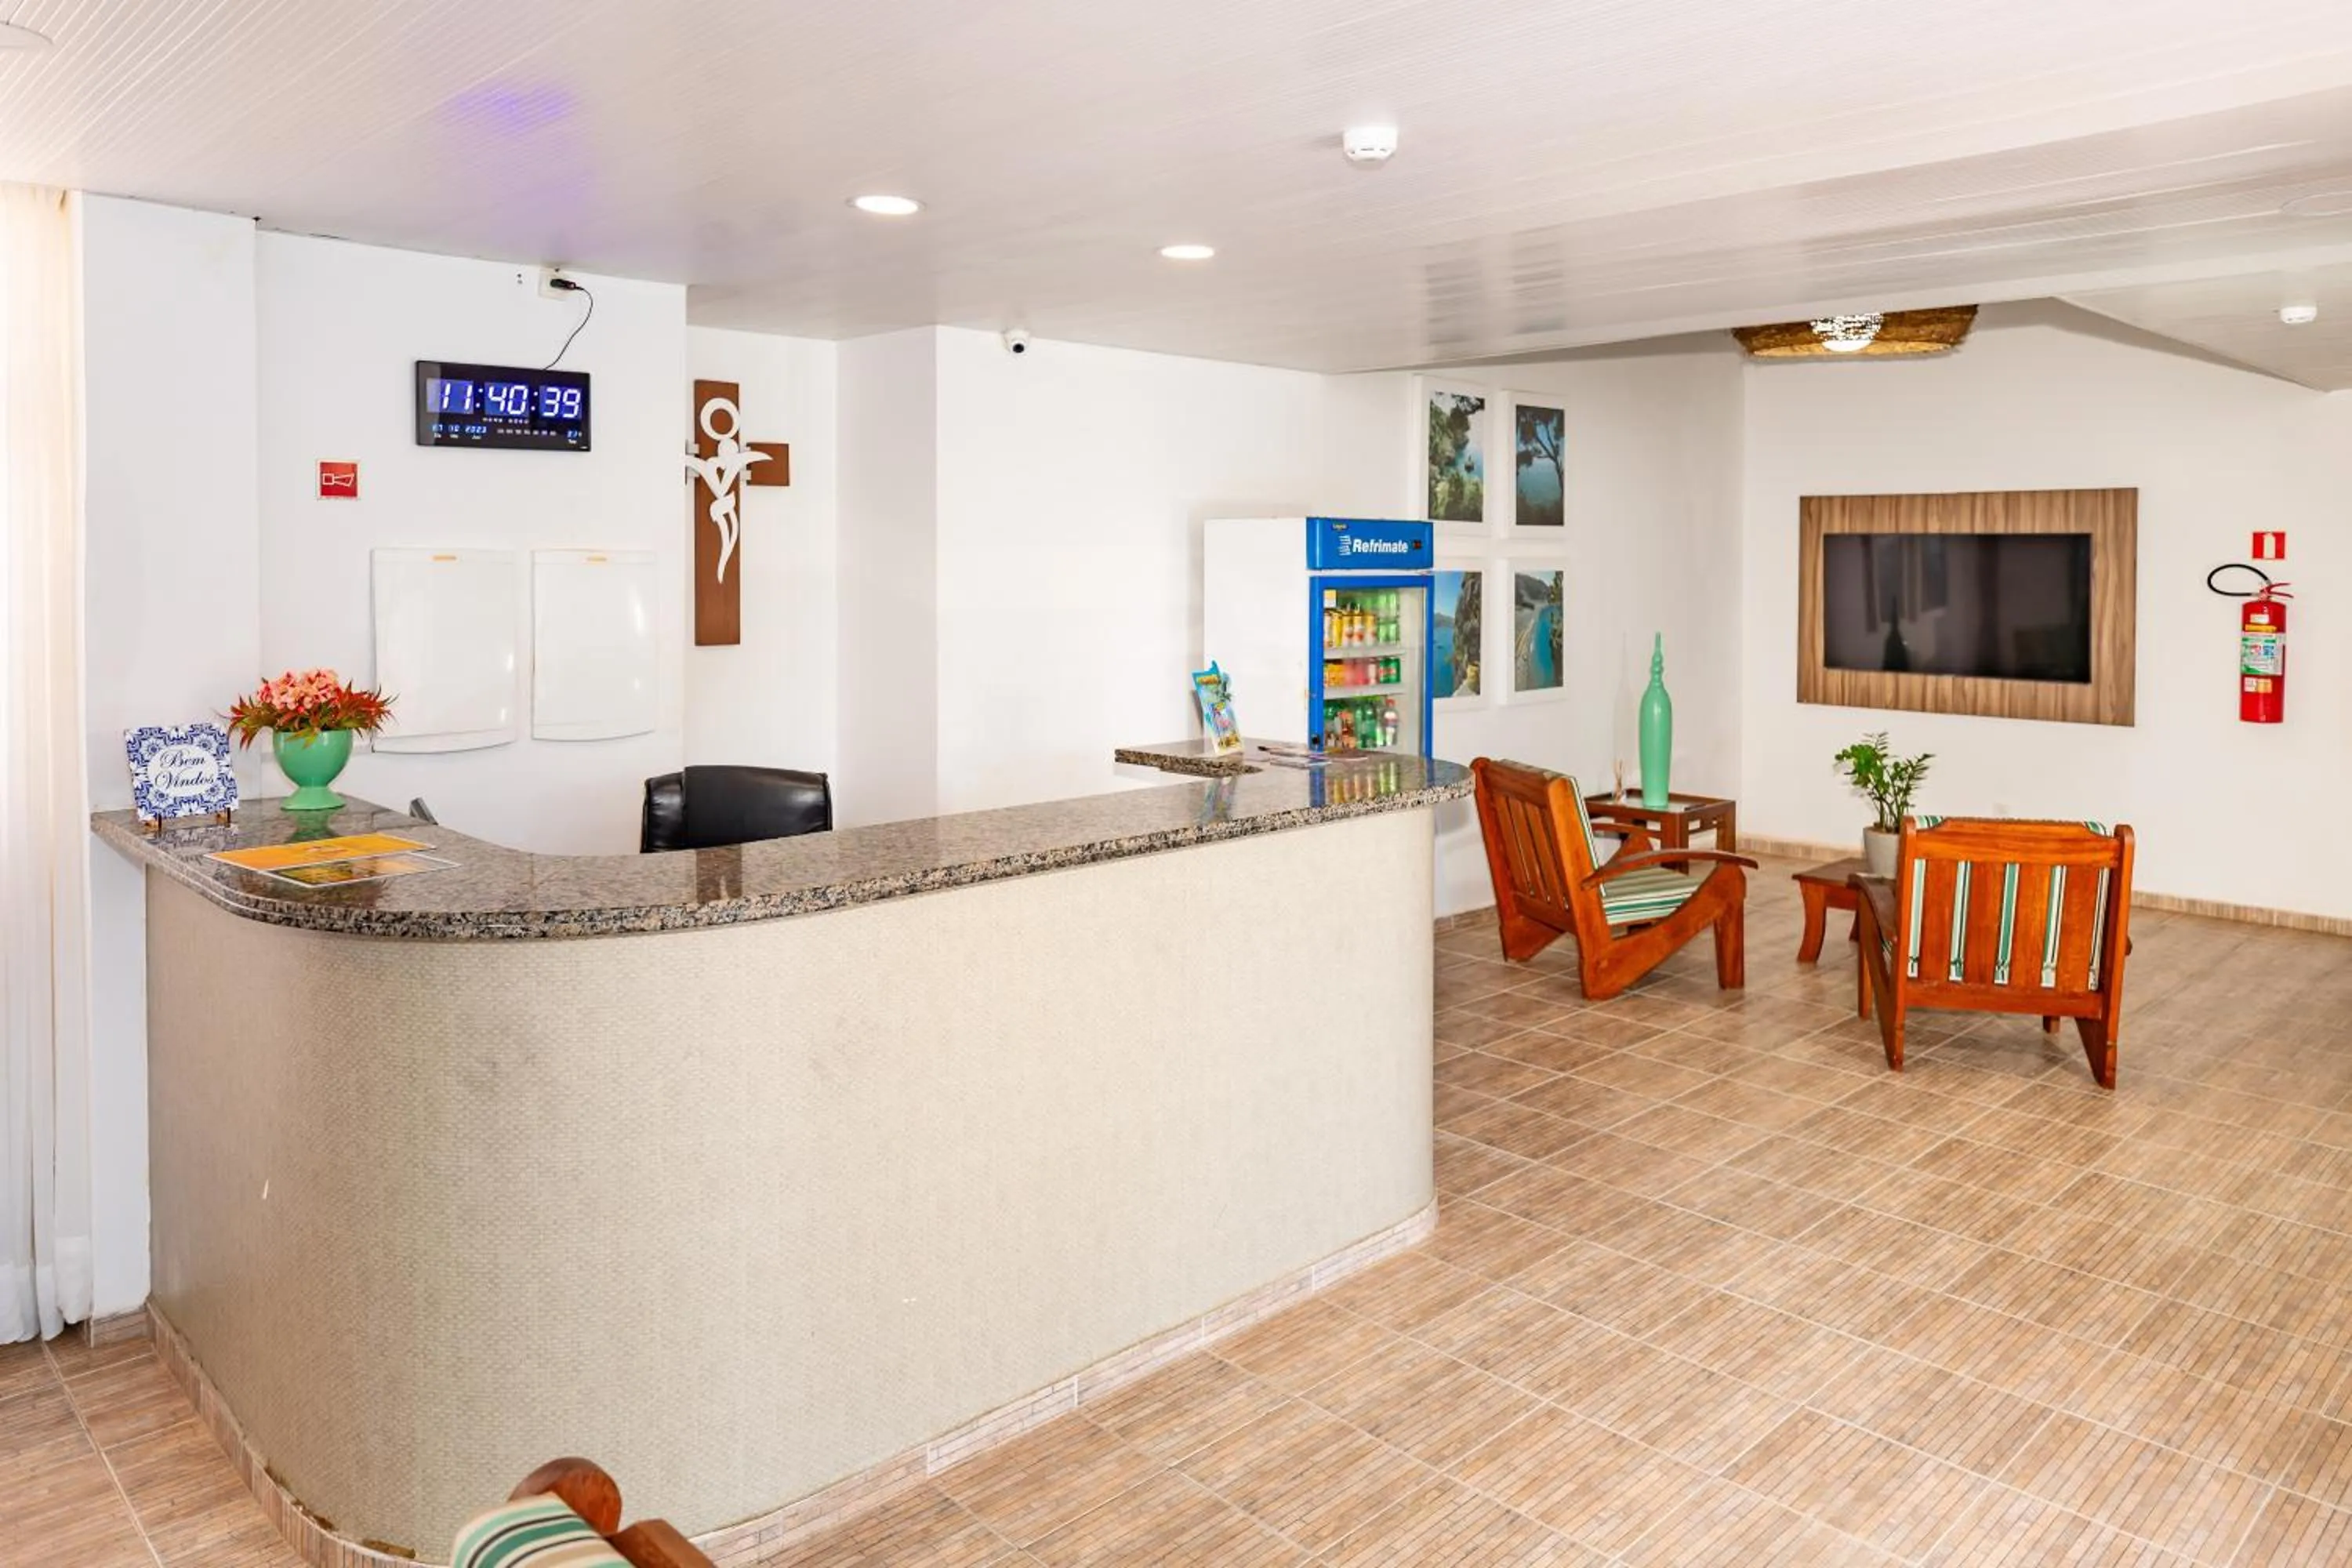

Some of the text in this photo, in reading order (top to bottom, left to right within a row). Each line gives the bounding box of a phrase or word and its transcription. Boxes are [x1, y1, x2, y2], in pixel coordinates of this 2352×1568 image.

[442, 383, 581, 418] 11:40:39
[1352, 538, 1409, 554] Refrimate
[160, 749, 205, 768] Bem
[155, 768, 214, 789] Vindos
